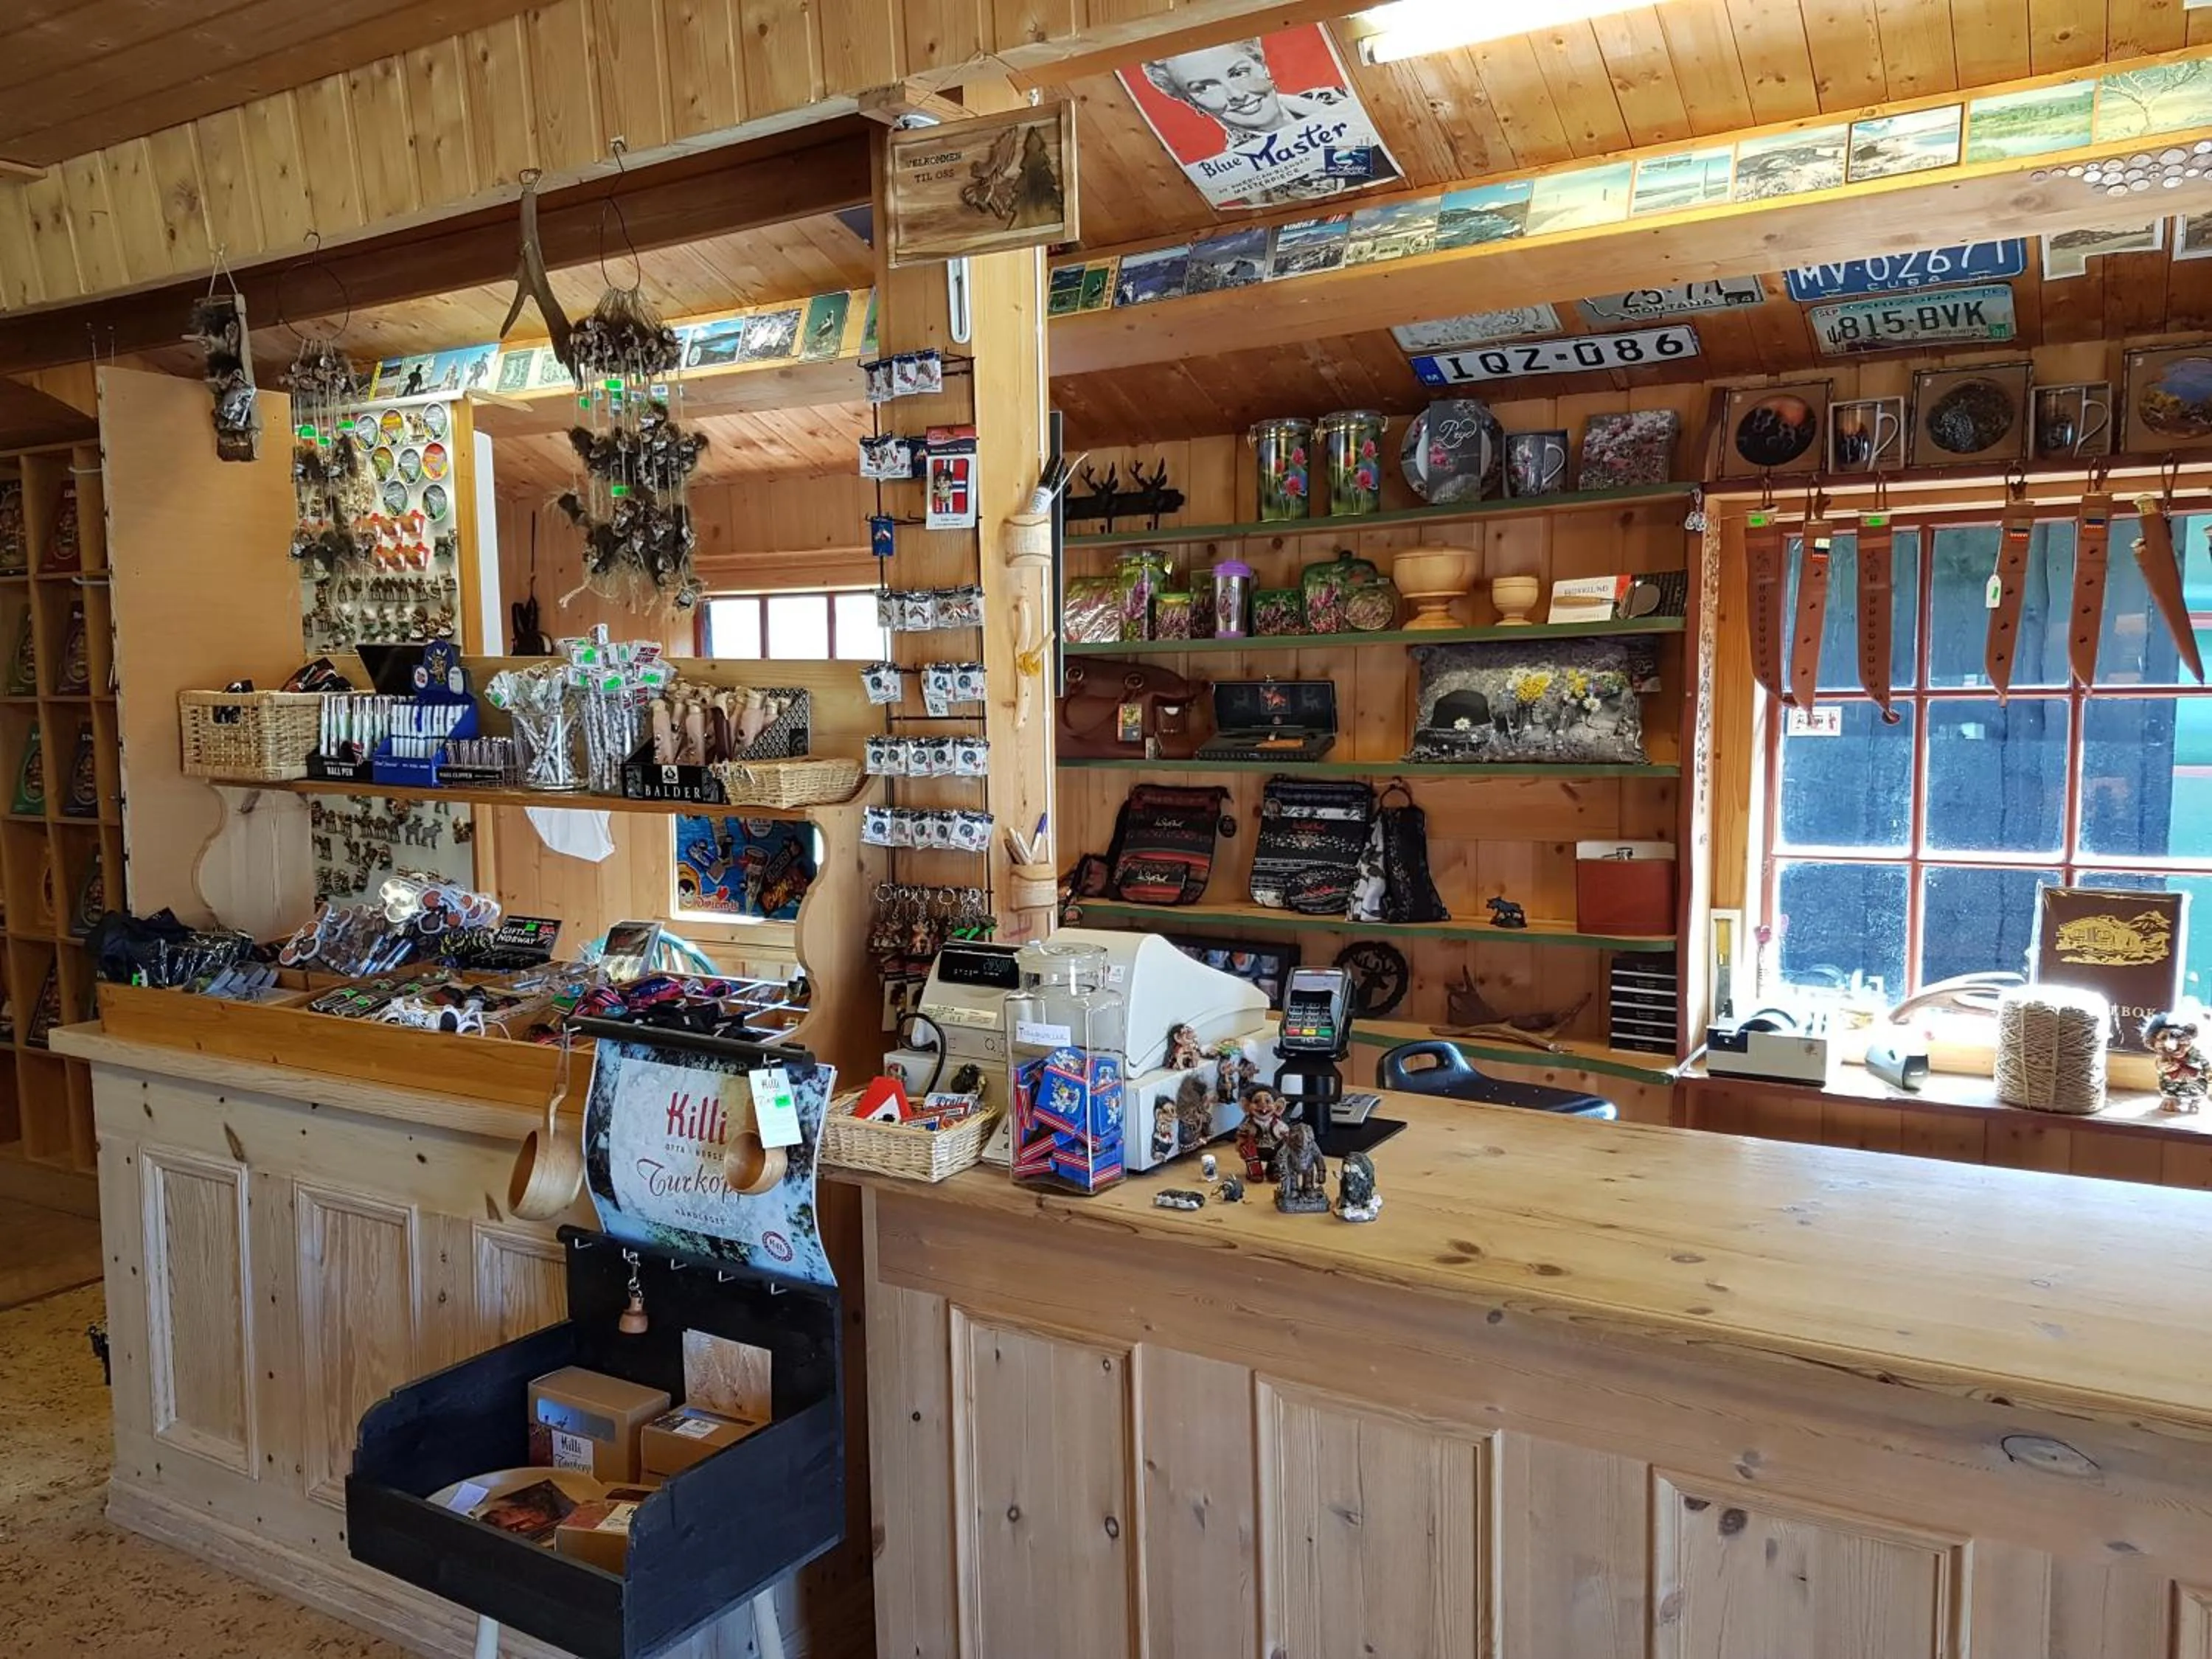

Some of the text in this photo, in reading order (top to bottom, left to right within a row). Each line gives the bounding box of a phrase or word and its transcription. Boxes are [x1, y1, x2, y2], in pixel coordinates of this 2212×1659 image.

[1198, 156, 1242, 178] Blue
[1233, 122, 1348, 172] Master
[914, 168, 955, 183] TIL OSS
[1234, 167, 1300, 195] MASTERPIECE
[1866, 275, 1941, 292] CUBA
[1627, 298, 1714, 316] MONTANA
[327, 766, 353, 776] BALL PEN
[644, 784, 702, 799] BALDER
[497, 933, 537, 945] NORWAY
[666, 1091, 728, 1145] Killi
[665, 1143, 686, 1154] OTTA
